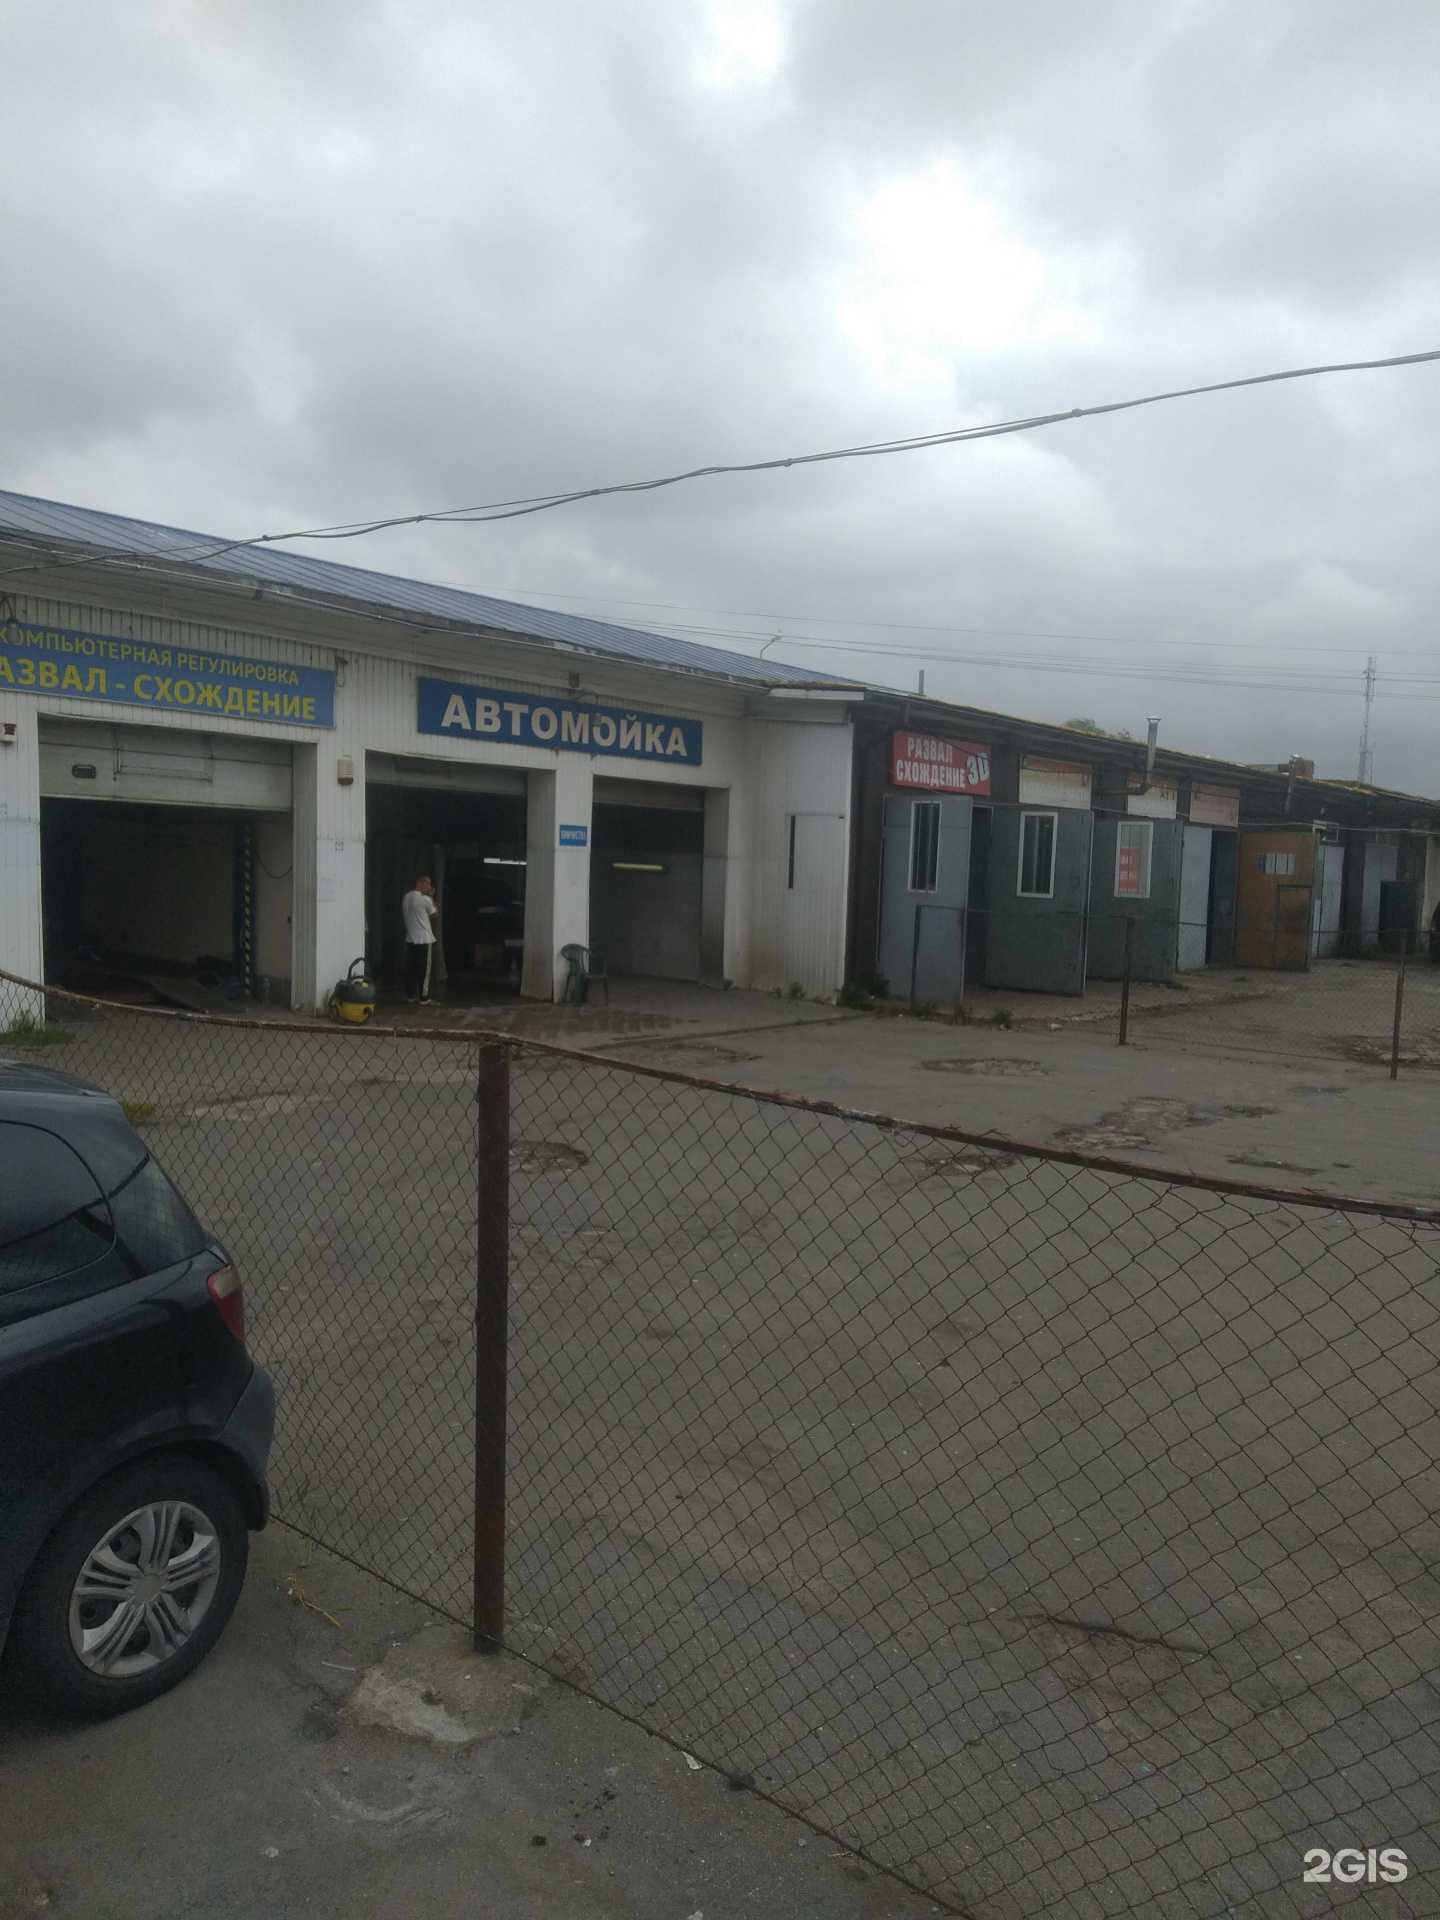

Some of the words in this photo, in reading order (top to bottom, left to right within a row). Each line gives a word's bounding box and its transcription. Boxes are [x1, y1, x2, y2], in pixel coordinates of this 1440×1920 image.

[177, 655, 298, 686] РЕГУЛИРОВКА
[133, 673, 315, 721] СХОЖДЕНИЕ
[441, 694, 688, 757] АВТОМОЙКА
[907, 737, 953, 763] РАЗВАЛ
[896, 759, 965, 788] СХОЖДЕНИЕ
